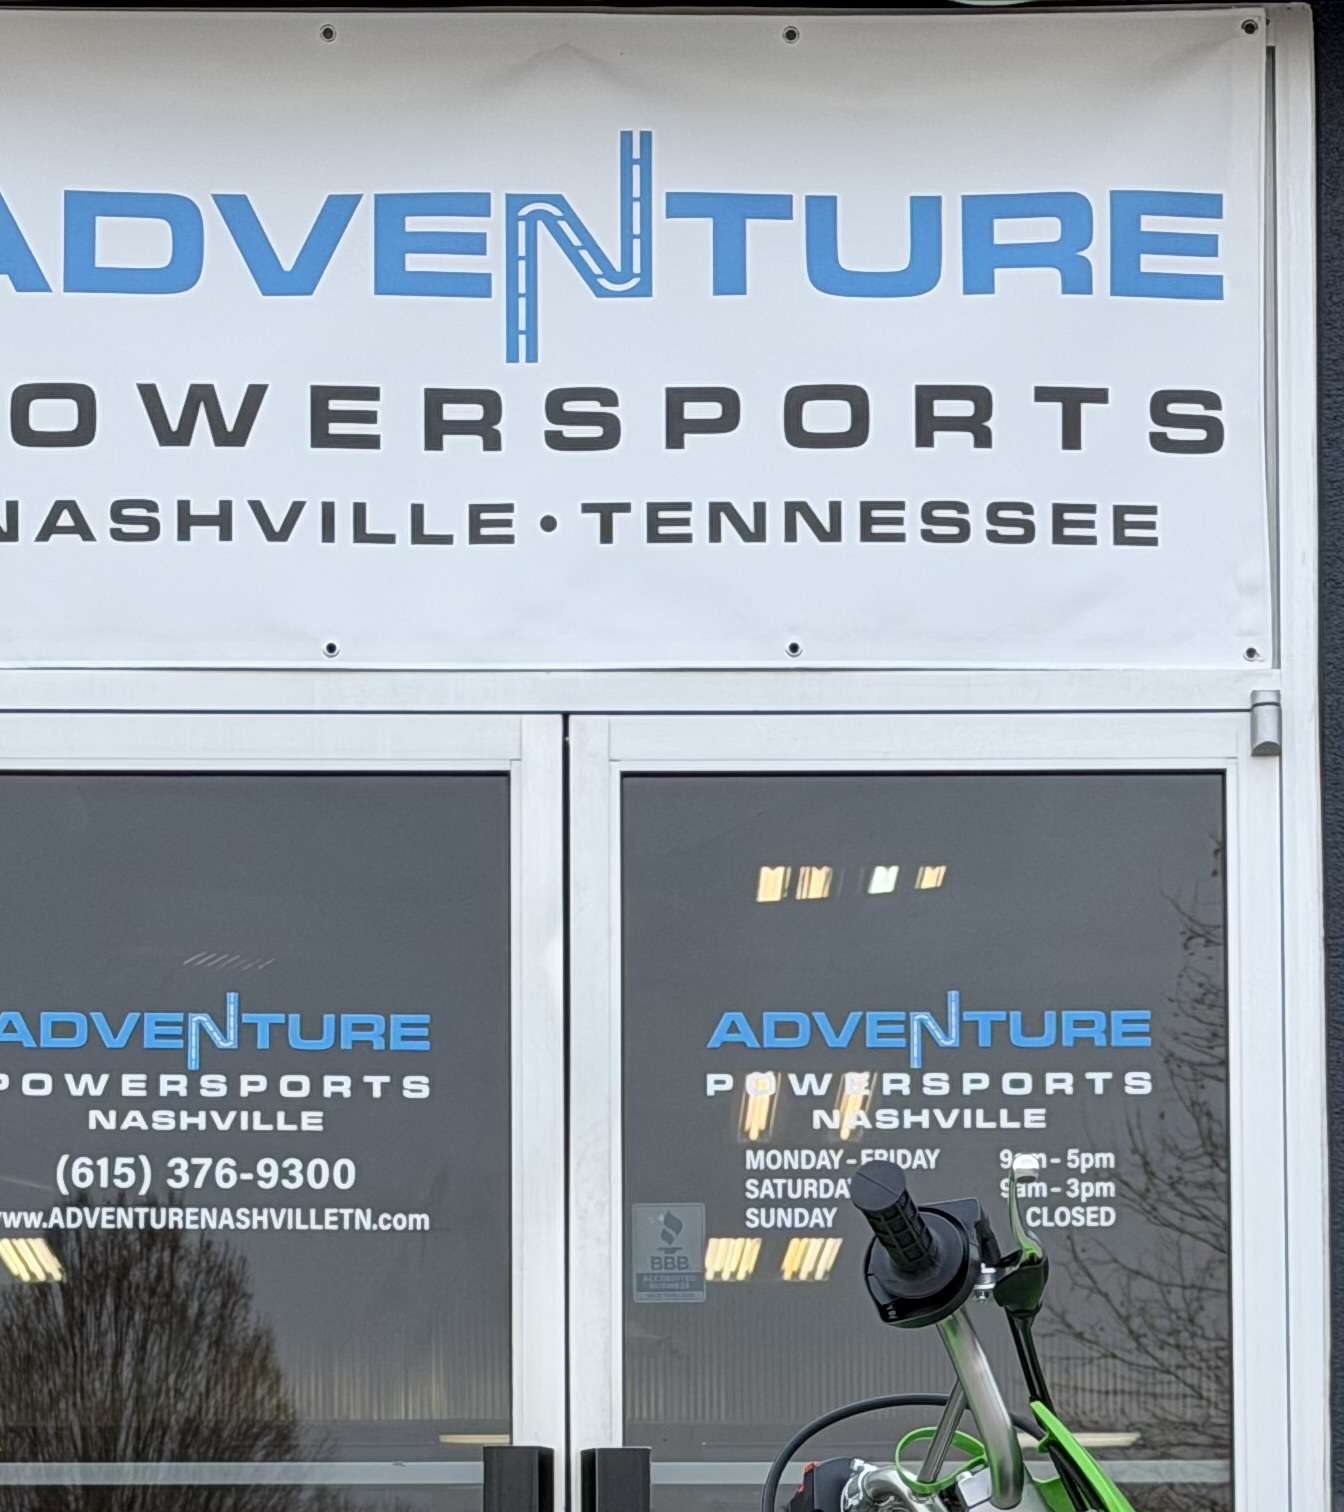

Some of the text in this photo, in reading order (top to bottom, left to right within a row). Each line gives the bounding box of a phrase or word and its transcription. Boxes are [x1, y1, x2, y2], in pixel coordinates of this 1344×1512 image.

[582, 501, 1160, 549] TENNESSEE
[706, 990, 1153, 1069] ADVENTURE
[706, 1071, 1153, 1097] POWERSPORTS
[88, 1110, 325, 1133] NASHVILLE
[812, 1107, 1048, 1131] NASHVILLE
[56, 1155, 356, 1196] (615) 376-9300
[745, 1177, 852, 1200] SATURDA
[745, 1206, 1117, 1229] SUNDAY CLOSED
[650, 1256, 690, 1271] BBB
